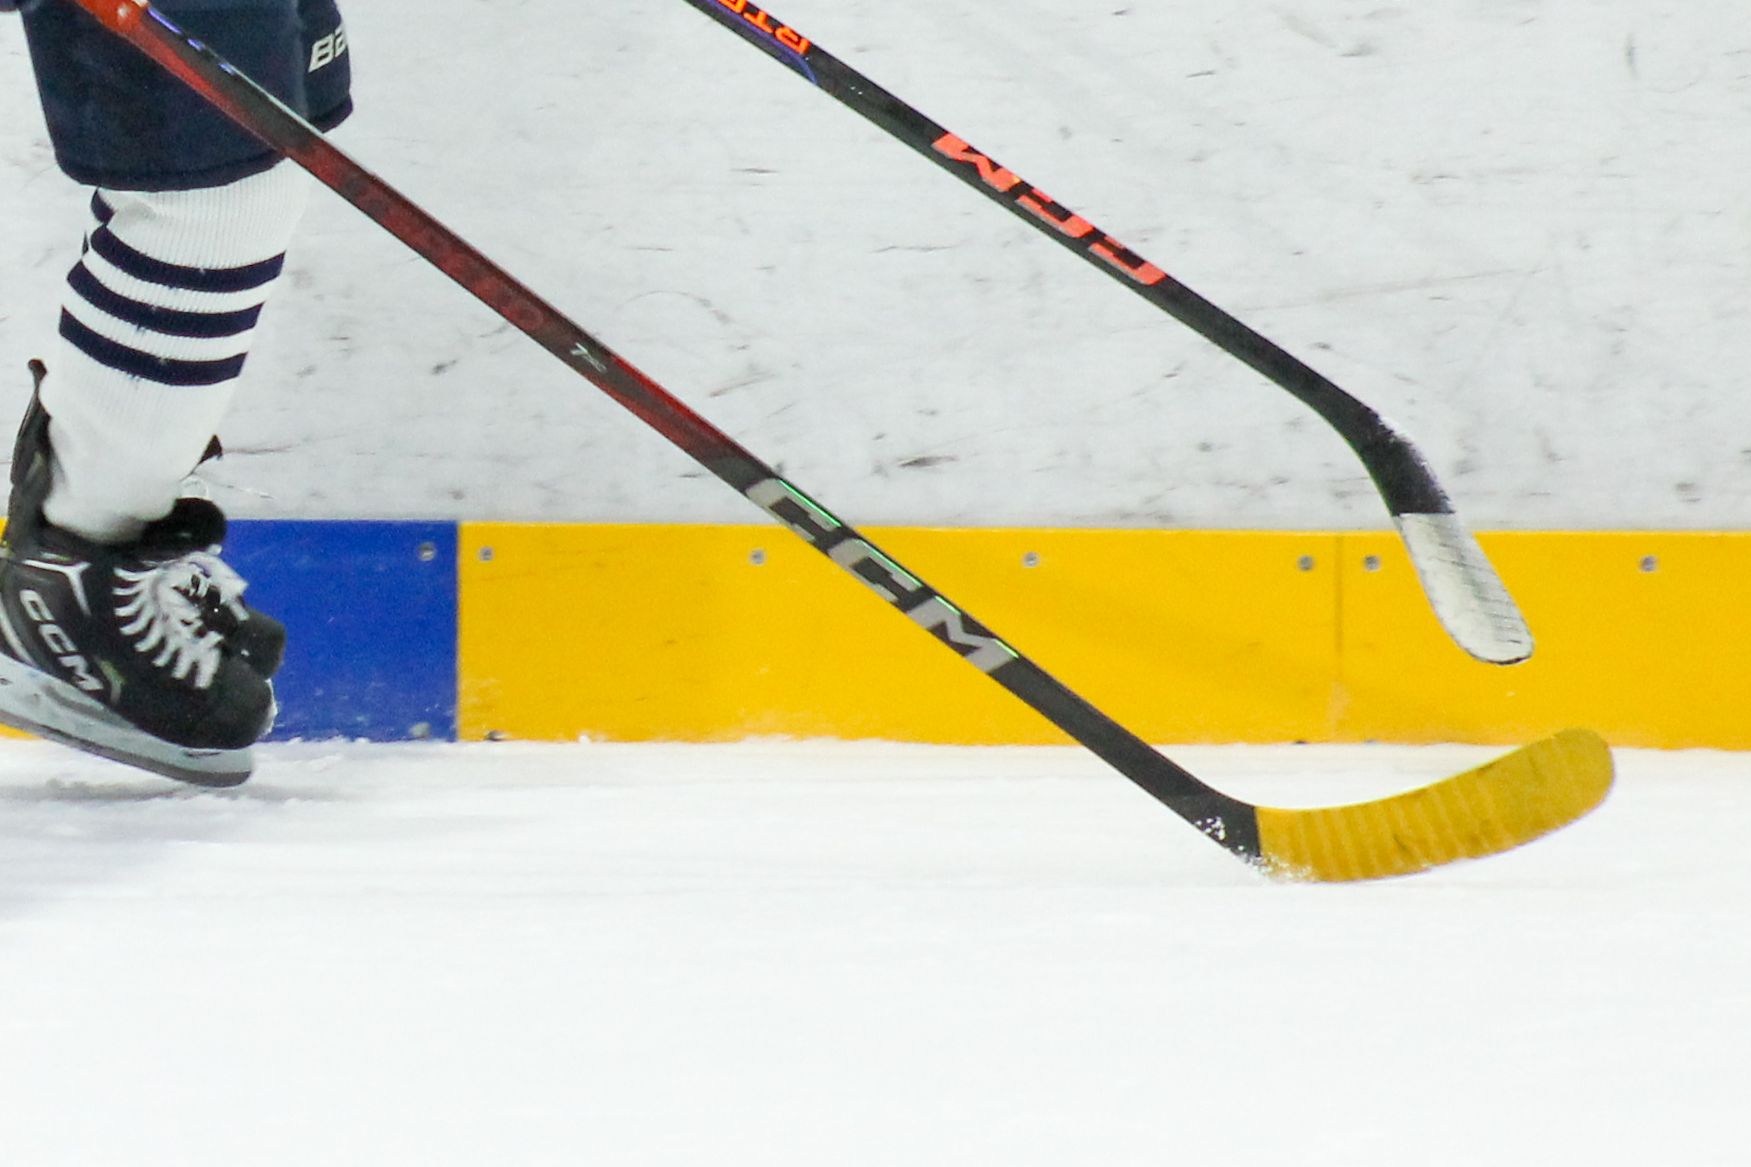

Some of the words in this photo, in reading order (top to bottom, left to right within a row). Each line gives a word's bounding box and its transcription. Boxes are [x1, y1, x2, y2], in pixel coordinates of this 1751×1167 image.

[933, 133, 1166, 285] CCM
[19, 588, 105, 692] CCM
[745, 478, 1020, 673] CCM
